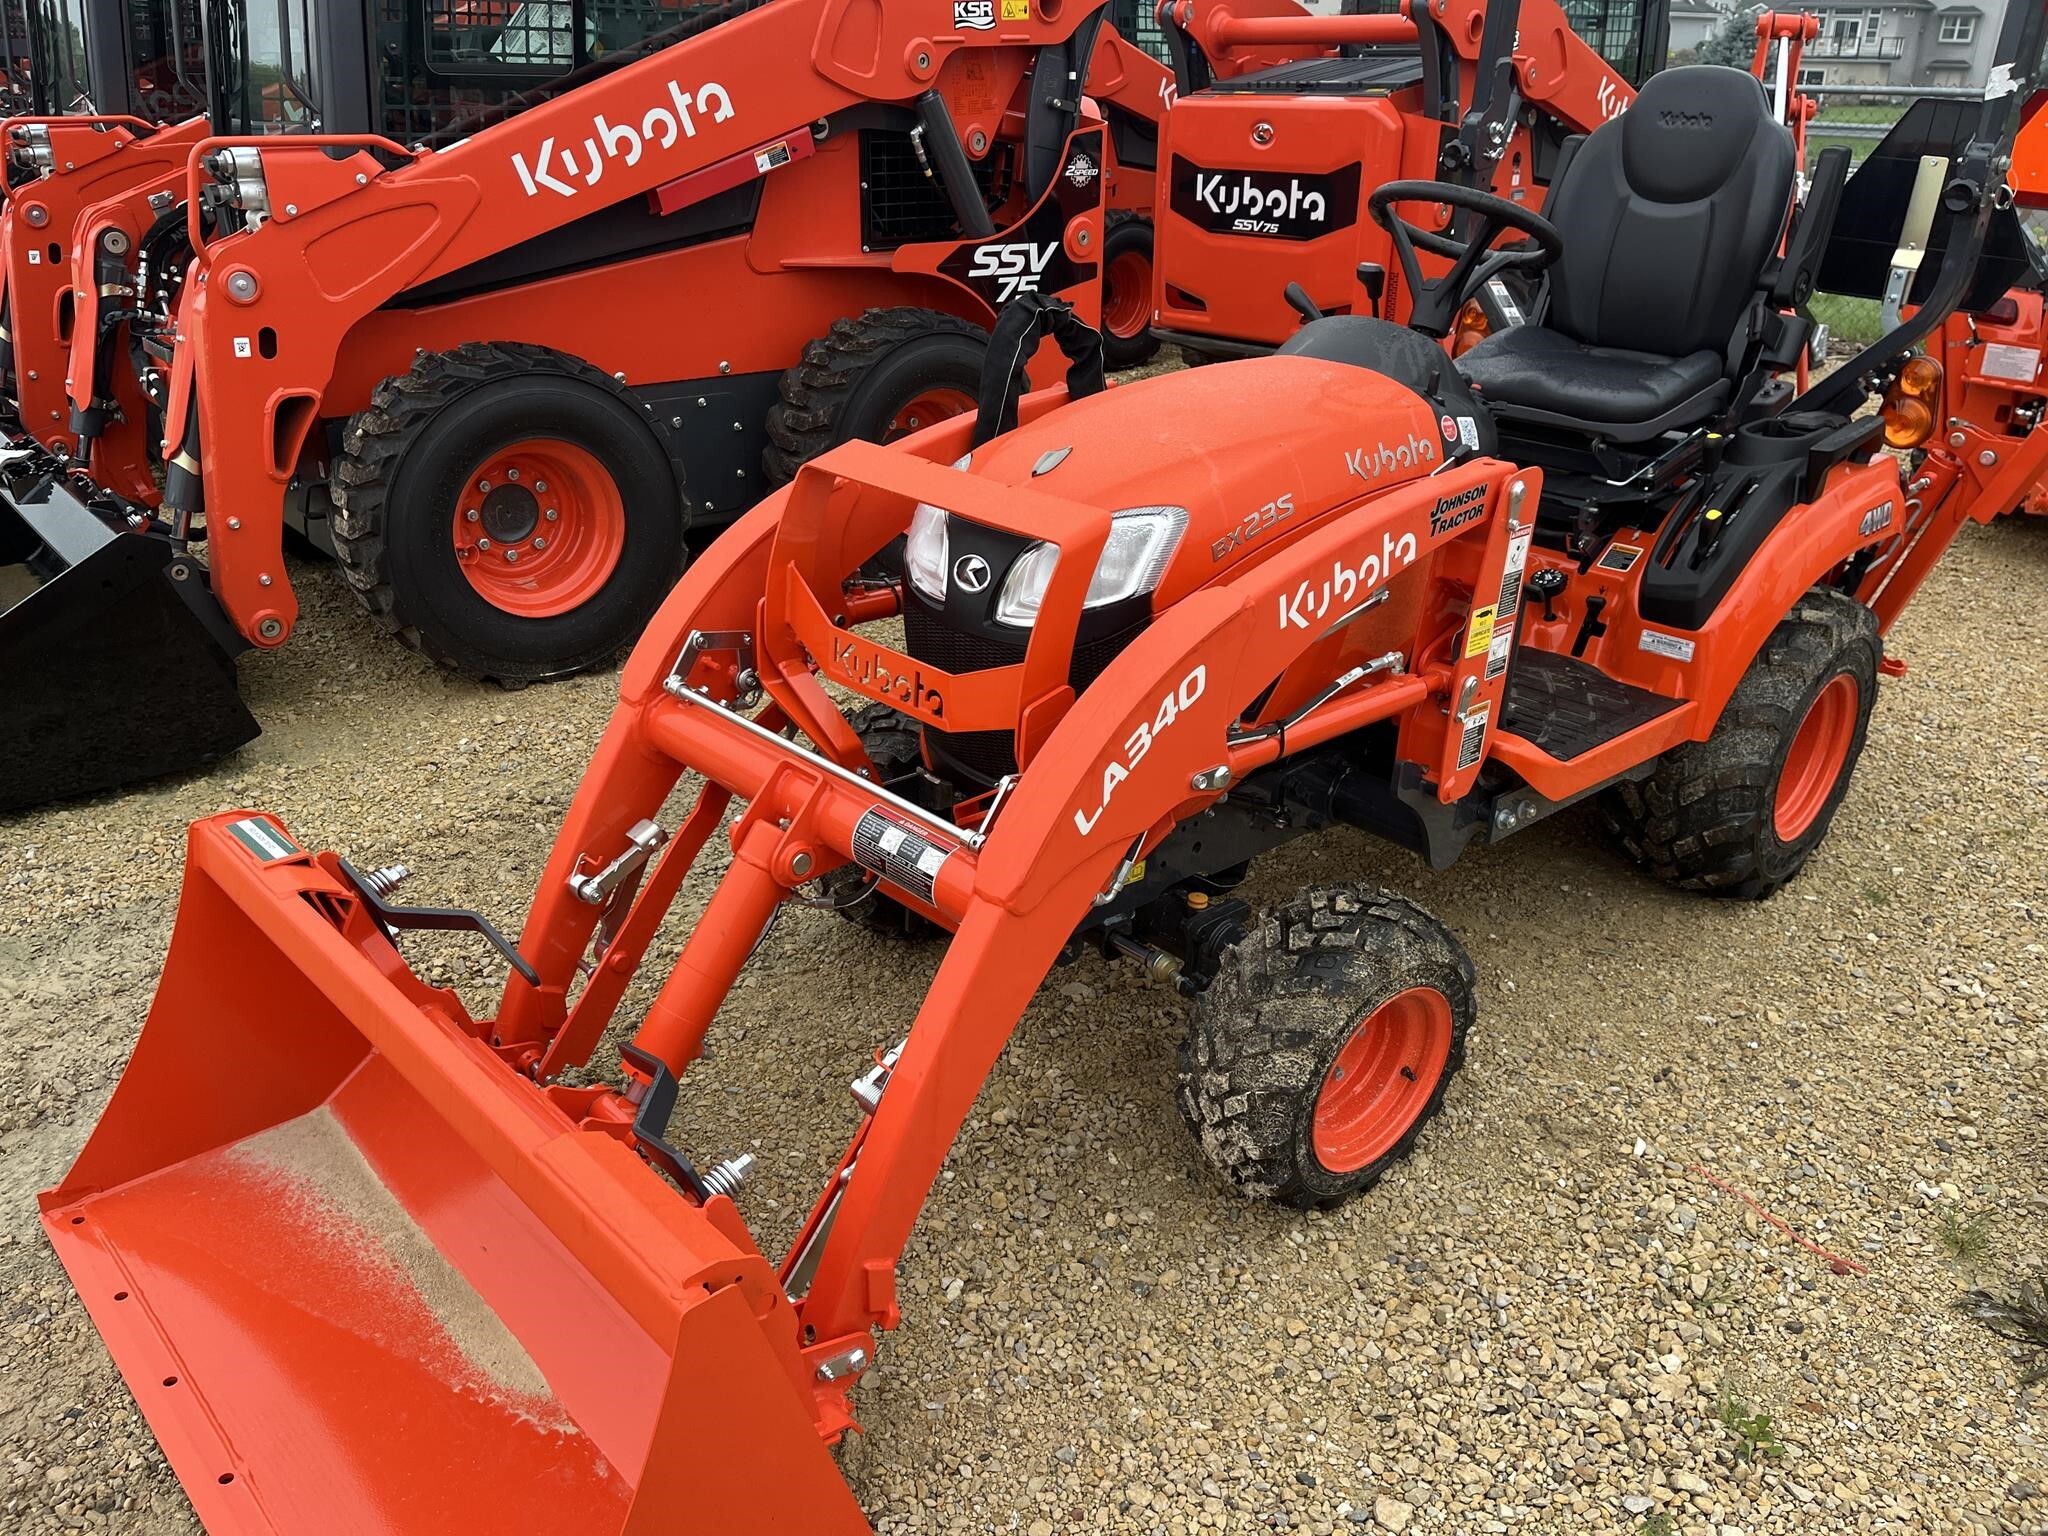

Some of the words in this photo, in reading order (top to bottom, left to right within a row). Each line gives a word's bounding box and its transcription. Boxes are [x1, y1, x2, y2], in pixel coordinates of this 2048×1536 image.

[954, 1, 993, 17] KSR
[511, 80, 736, 198] Kubota
[1196, 173, 1326, 222] Kubota
[968, 242, 1060, 277] SSV
[996, 275, 1041, 303] 75
[1344, 433, 1435, 480] Kubota
[1430, 484, 1488, 519] JOHNSON
[1859, 500, 1893, 537] 4WD
[1430, 504, 1485, 538] TRACTOR
[1279, 532, 1417, 630] Kubota
[834, 636, 944, 719] Kubota
[1073, 664, 1207, 837] LA340
[904, 821, 929, 837] DANGER
